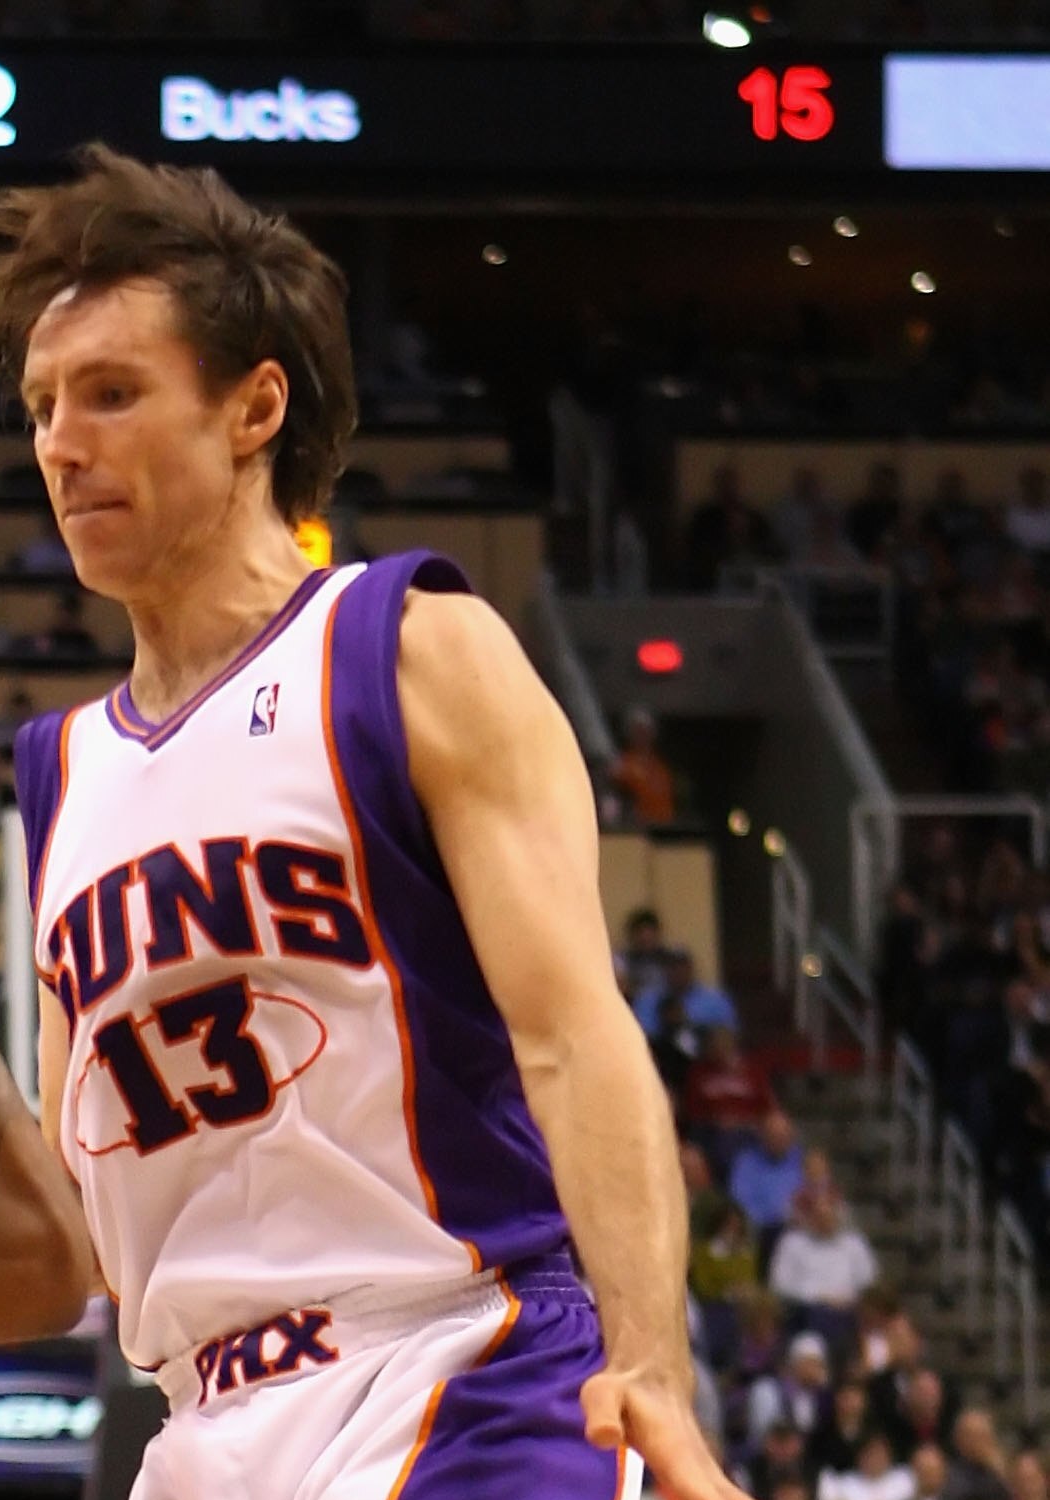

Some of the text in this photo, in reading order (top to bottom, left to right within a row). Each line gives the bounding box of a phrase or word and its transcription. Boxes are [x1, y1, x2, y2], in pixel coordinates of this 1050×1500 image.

[161, 77, 361, 142] Bucks
[738, 66, 834, 141] 15
[92, 973, 277, 1158] 13
